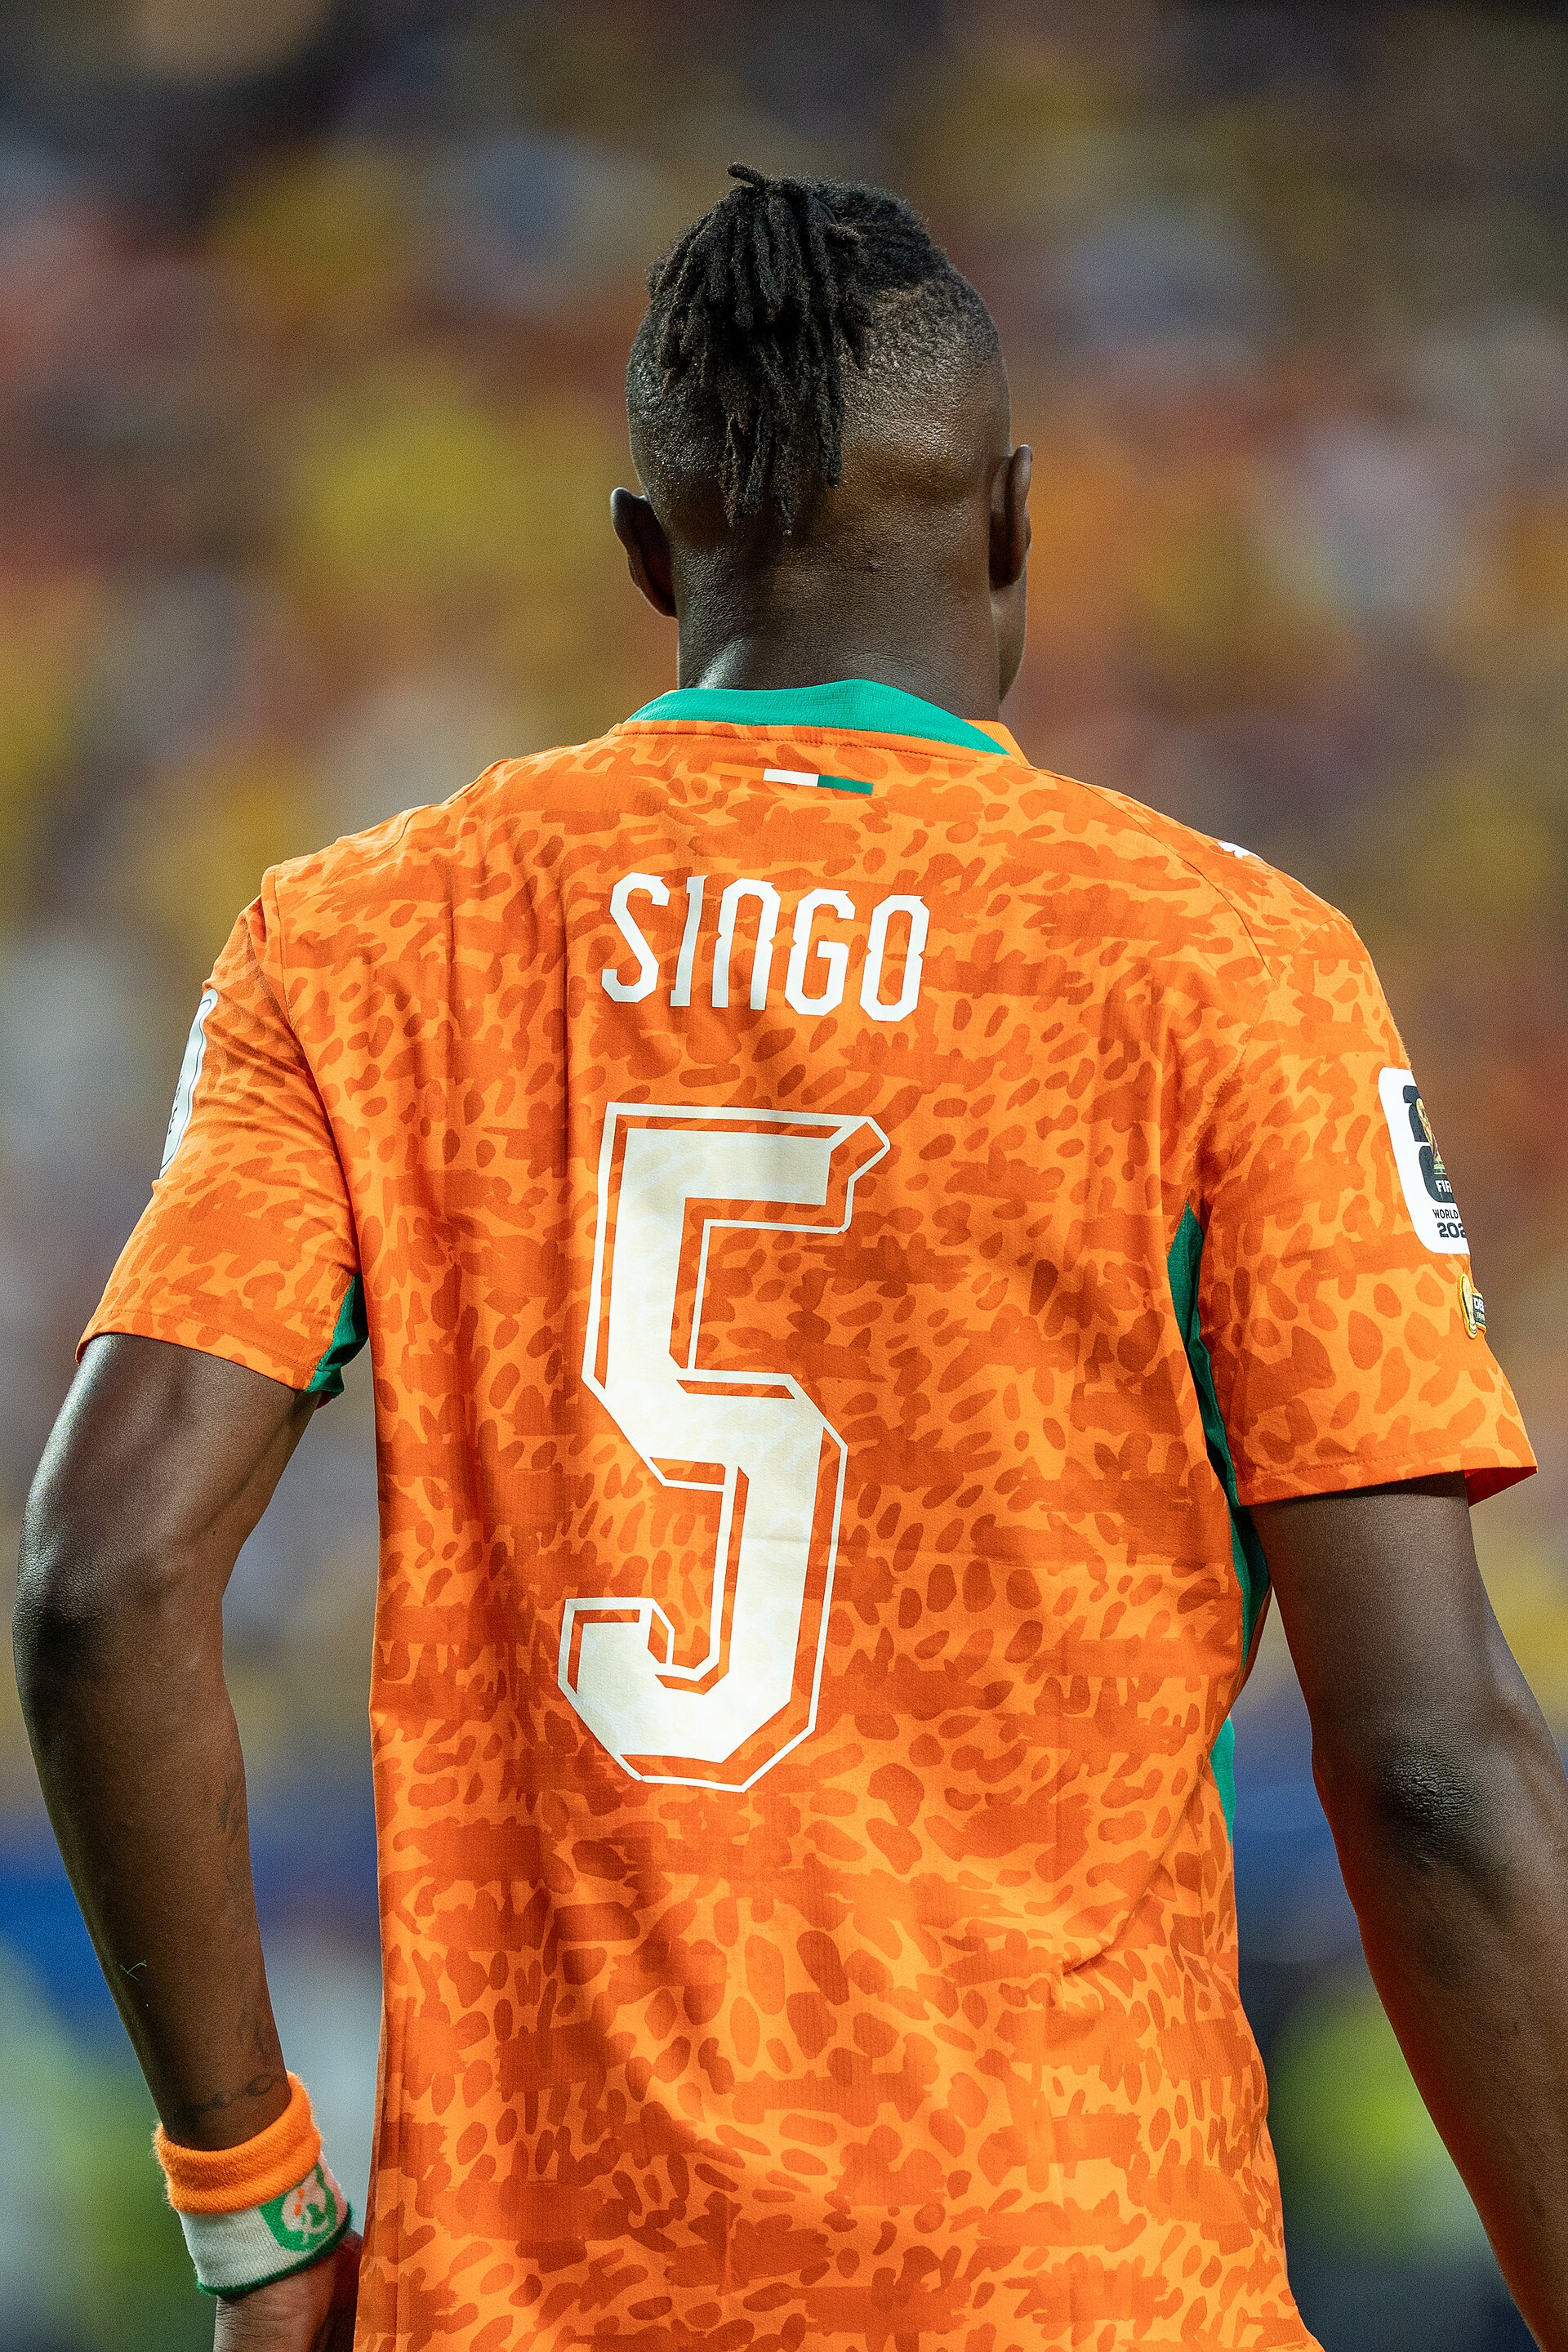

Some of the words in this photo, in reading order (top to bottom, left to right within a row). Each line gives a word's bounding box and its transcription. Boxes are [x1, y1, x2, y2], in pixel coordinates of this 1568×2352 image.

[601, 871, 930, 1022] SINGO
[1432, 1209, 1459, 1219] WORLD
[557, 1102, 890, 1793] 5
